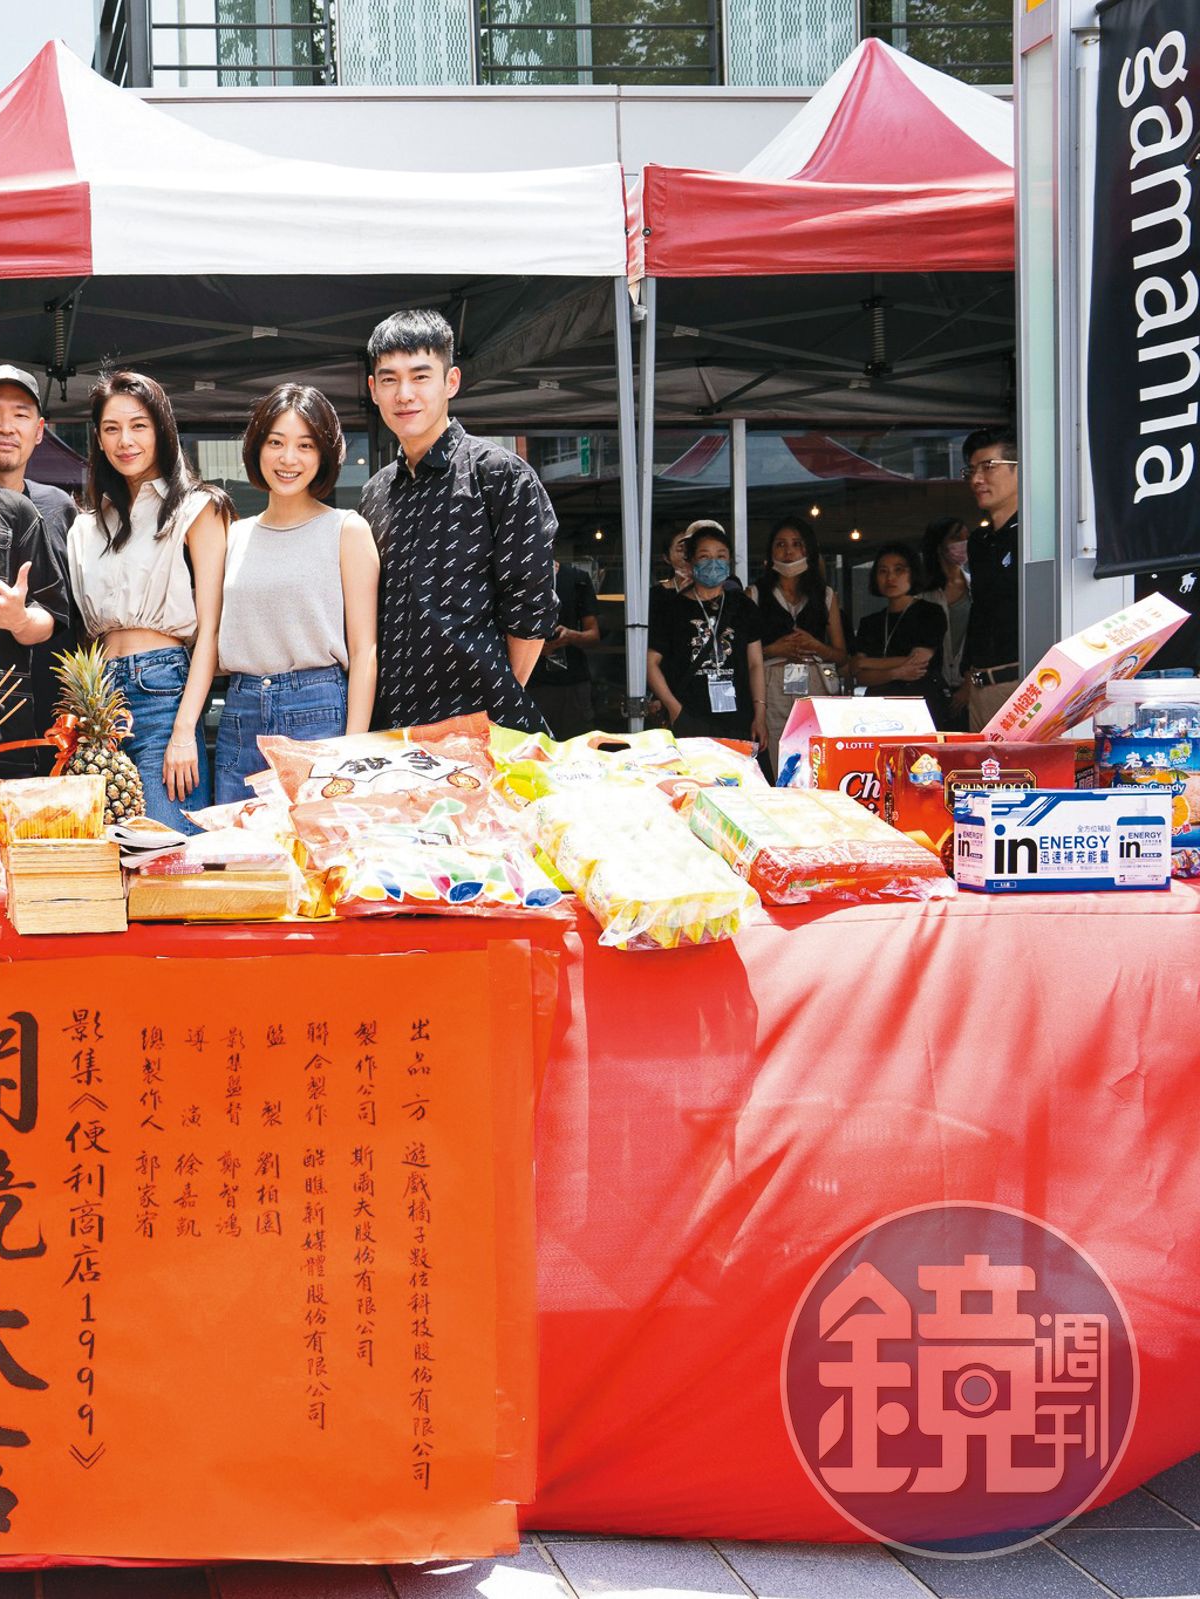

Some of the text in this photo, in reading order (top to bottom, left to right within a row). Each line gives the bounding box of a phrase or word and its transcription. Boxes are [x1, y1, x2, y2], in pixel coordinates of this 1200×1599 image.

[1118, 30, 1200, 504] gamania
[845, 742, 875, 750] LOTTE
[958, 833, 970, 857] in
[1039, 835, 1110, 850] ENERGY
[1128, 831, 1162, 840] ENERGY
[994, 824, 1038, 875] in
[1119, 834, 1141, 858] in
[1039, 850, 1110, 865] 迅速補充能量
